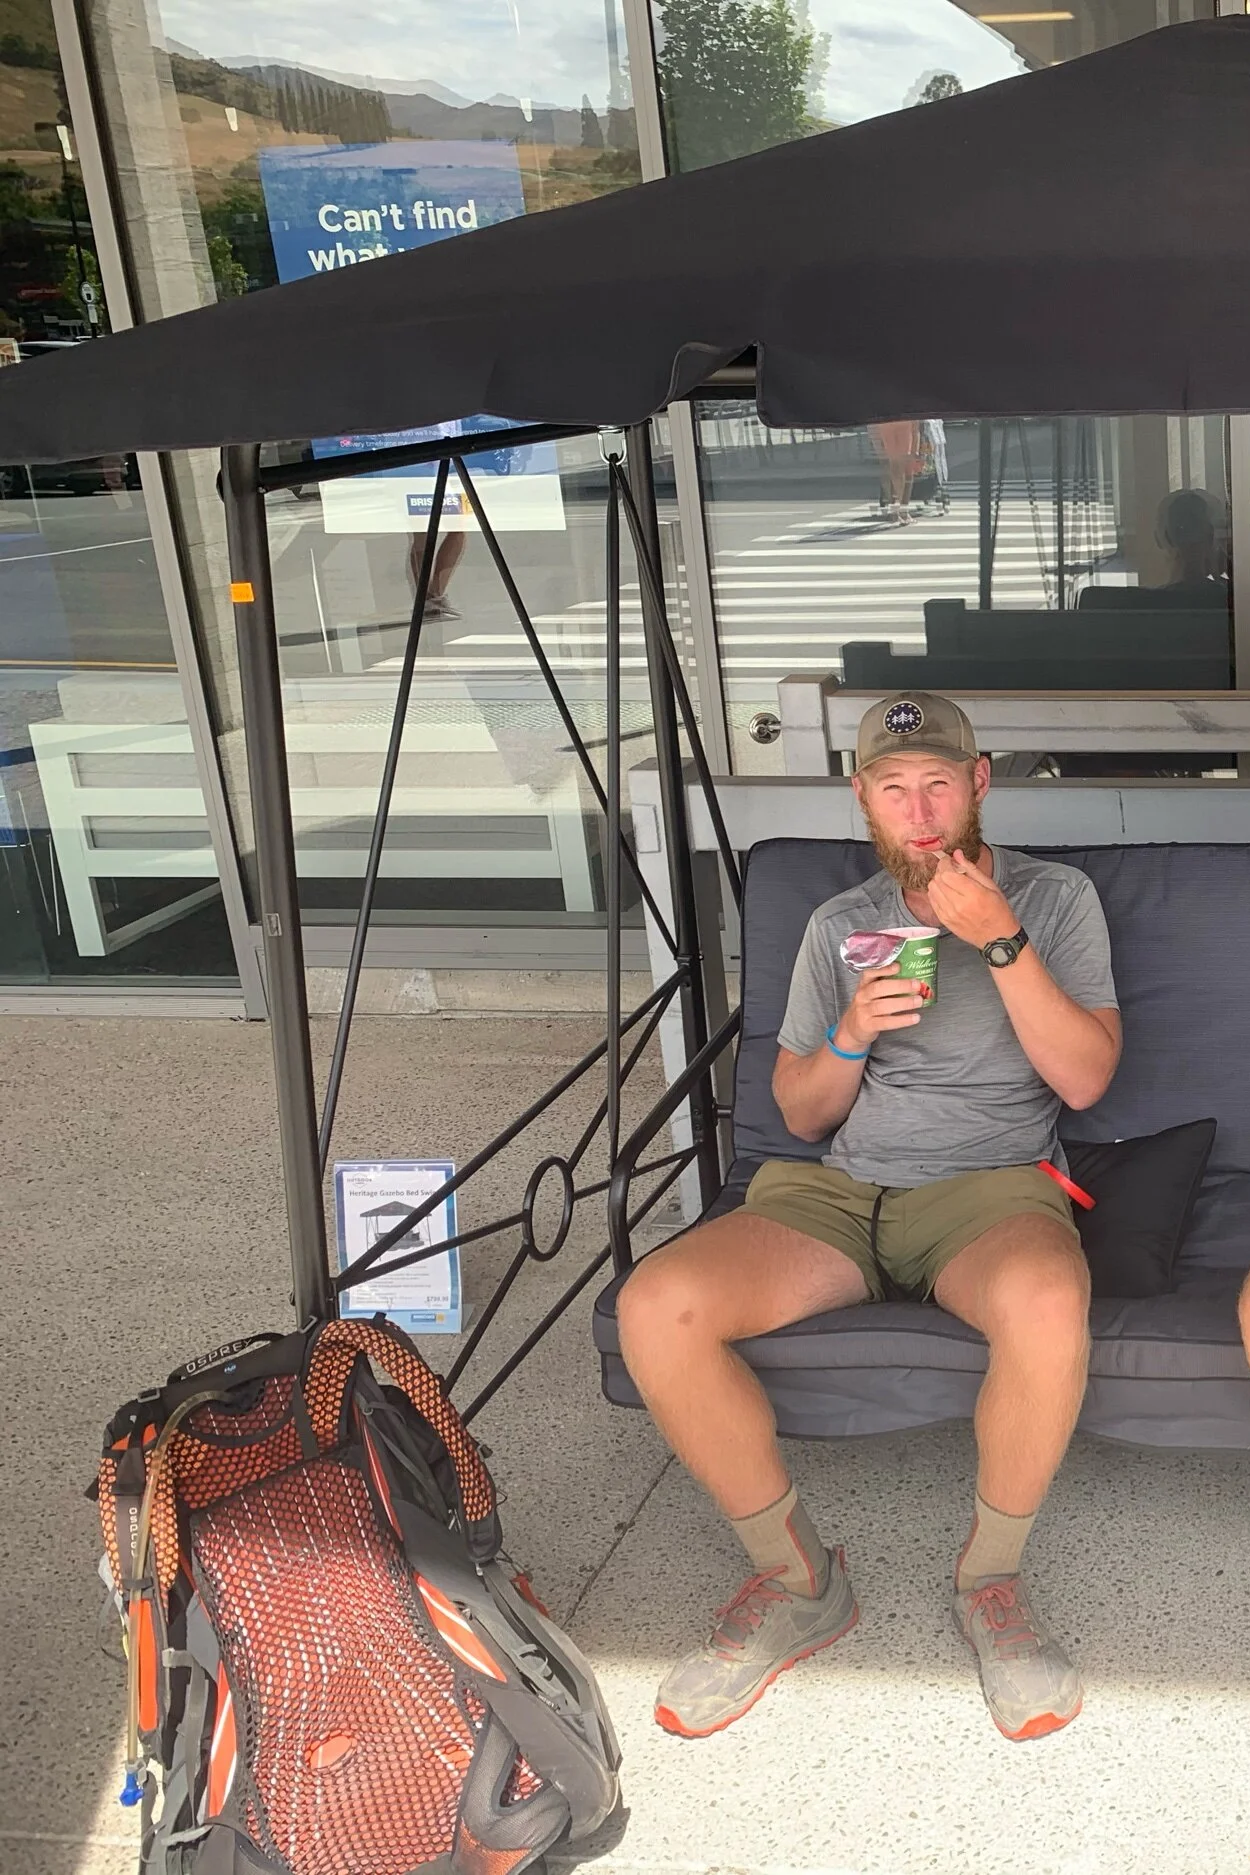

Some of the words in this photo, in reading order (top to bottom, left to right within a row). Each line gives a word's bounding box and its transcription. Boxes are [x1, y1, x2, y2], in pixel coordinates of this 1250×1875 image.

[318, 203, 405, 233] Can't
[413, 200, 478, 230] find
[410, 497, 459, 507] BRISES
[349, 1190, 377, 1198] Heritage
[379, 1189, 404, 1197] Gazebo
[186, 1339, 252, 1373] OSPREY
